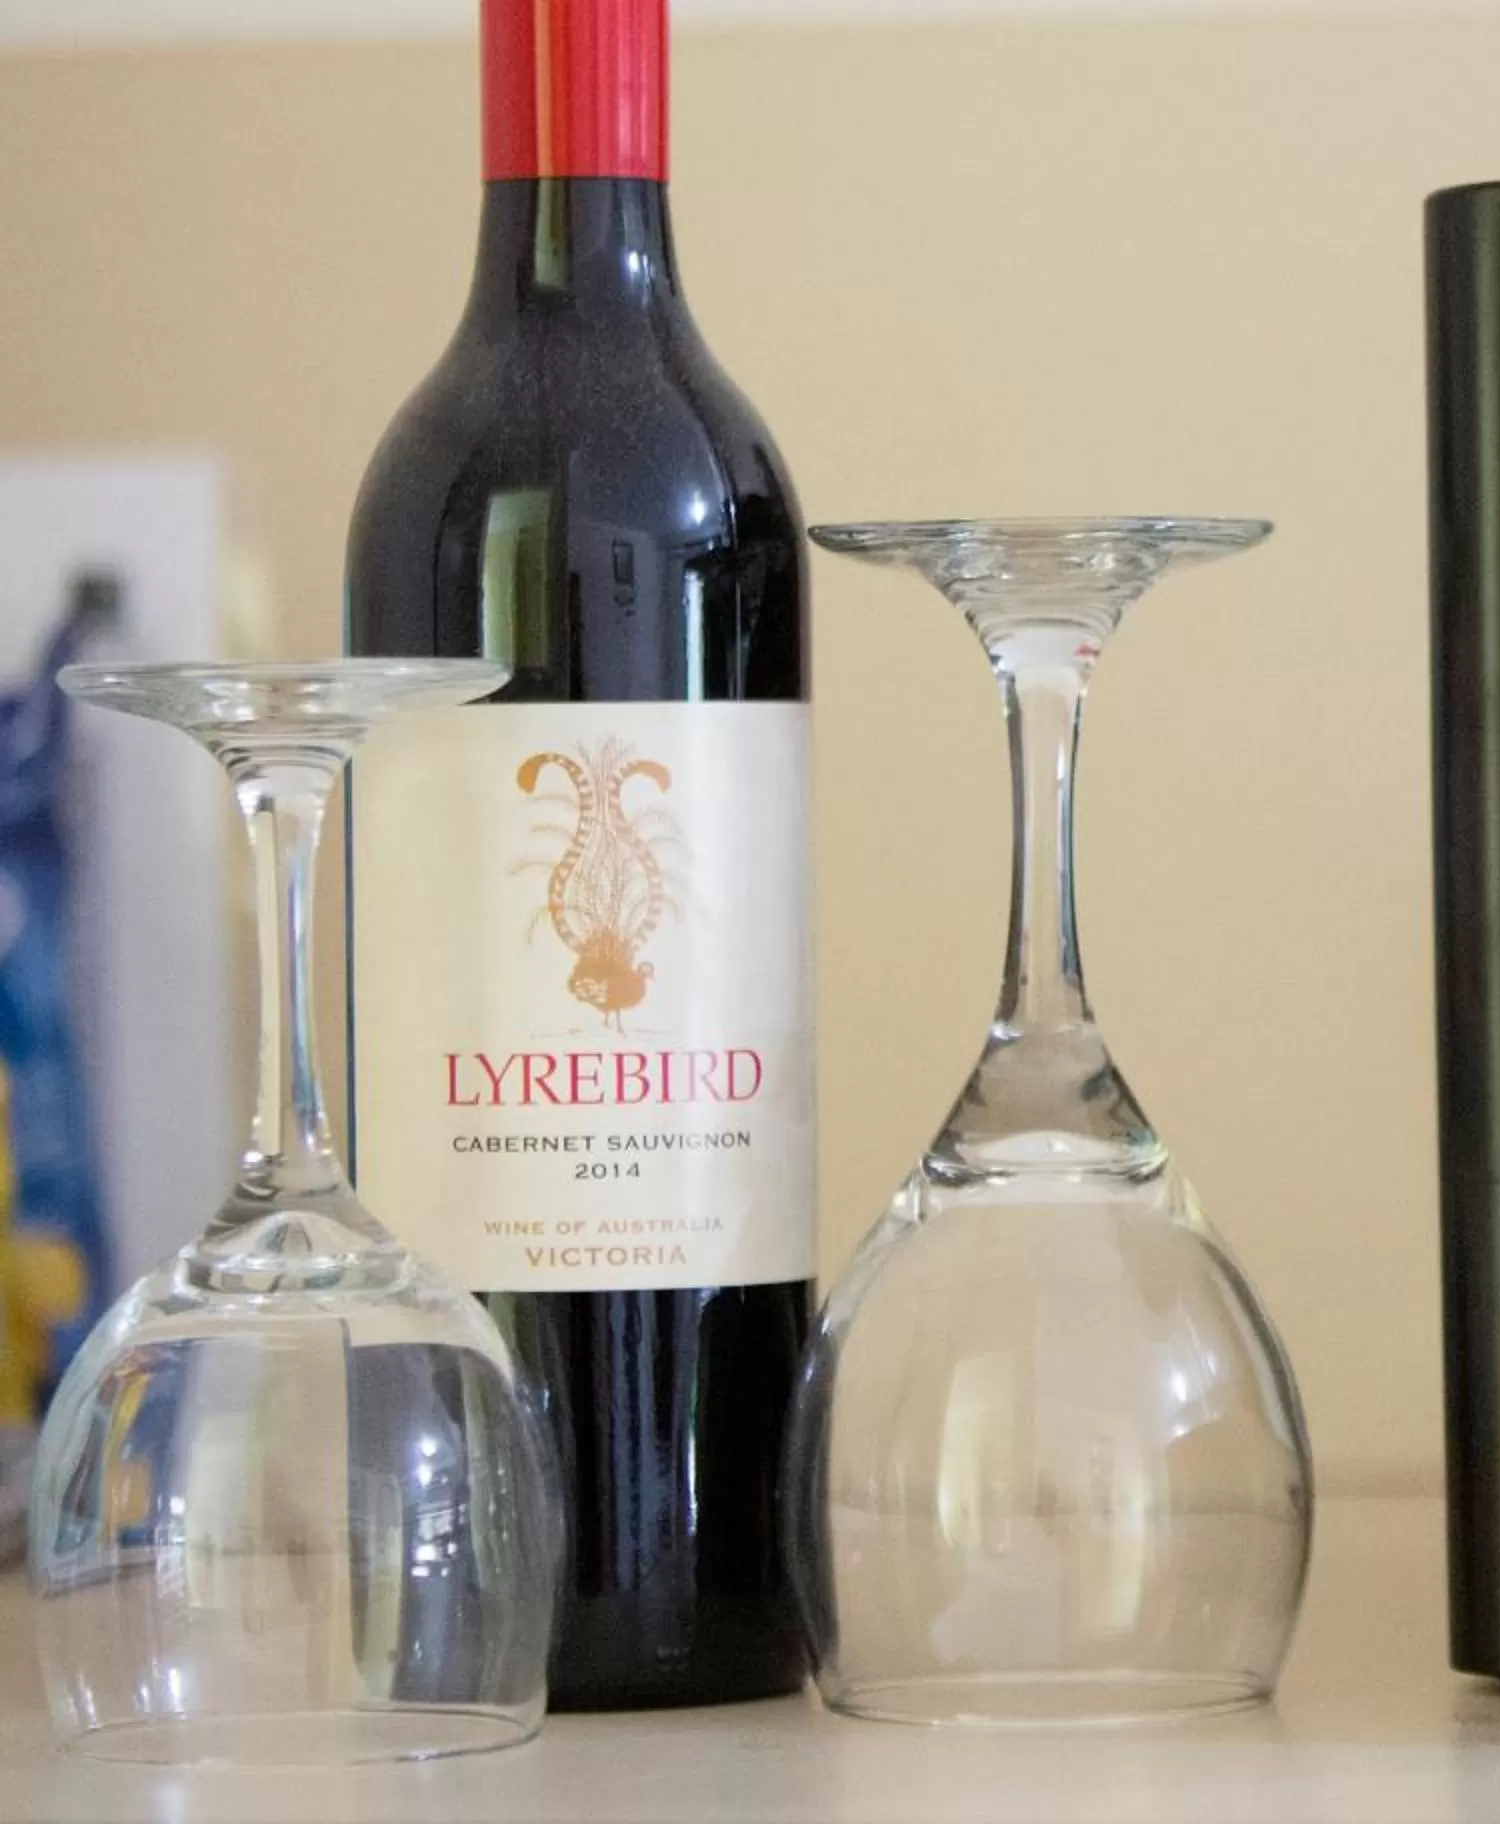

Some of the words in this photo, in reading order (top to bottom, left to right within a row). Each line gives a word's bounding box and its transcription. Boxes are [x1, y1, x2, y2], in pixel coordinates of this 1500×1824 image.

[445, 1049, 763, 1106] LYREBIRD
[452, 1135, 597, 1153] CABERNET
[606, 1130, 752, 1152] SAUVIGNON
[574, 1162, 641, 1180] 2014
[484, 1220, 545, 1236] WINE
[556, 1219, 587, 1236] OF
[597, 1218, 726, 1235] AUSTRALIA
[525, 1244, 688, 1268] VICTORIA
